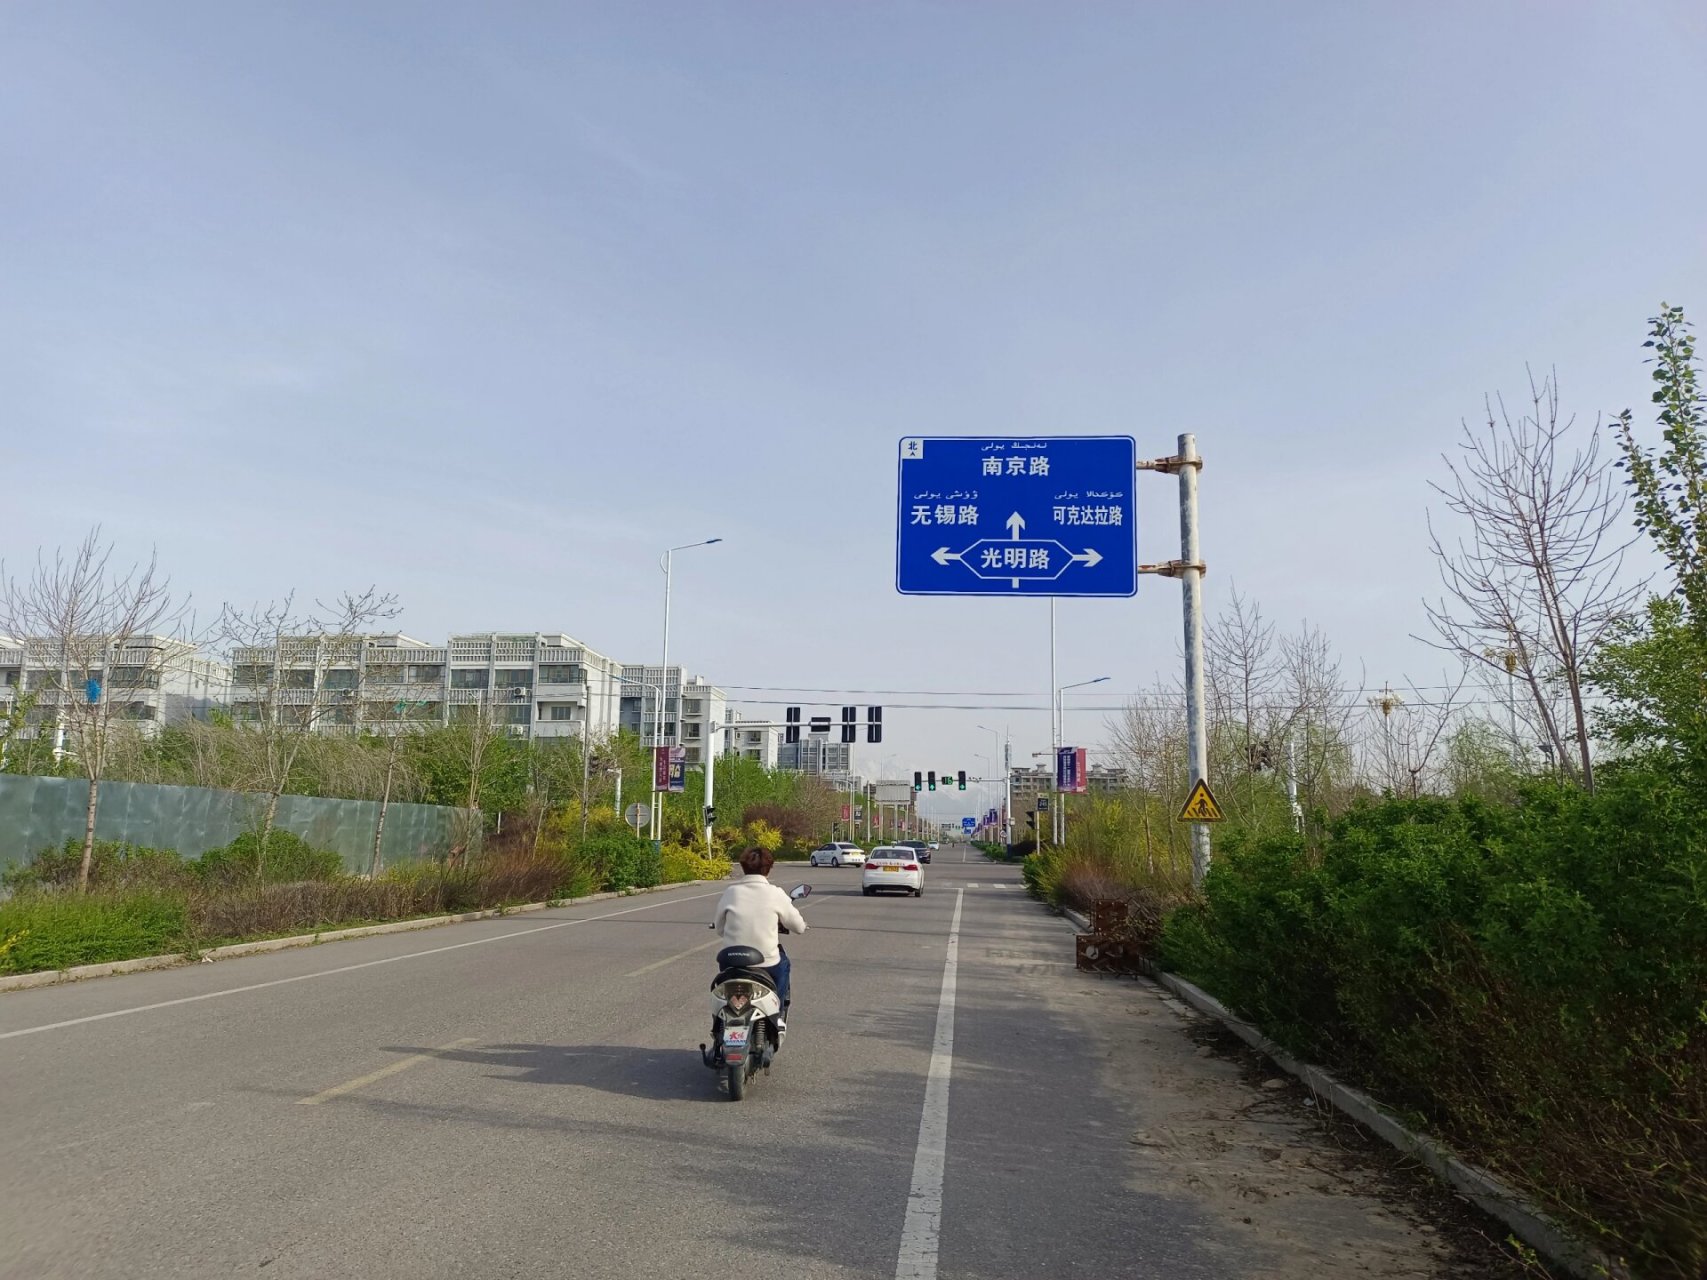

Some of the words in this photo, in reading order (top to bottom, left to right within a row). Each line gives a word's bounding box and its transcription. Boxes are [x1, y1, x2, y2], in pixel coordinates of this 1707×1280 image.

[908, 441, 918, 450] 北
[981, 456, 1050, 476] 南京路
[910, 504, 979, 525] 无锡路
[1053, 505, 1123, 526] 可克达拉路
[981, 547, 1050, 569] 光明路
